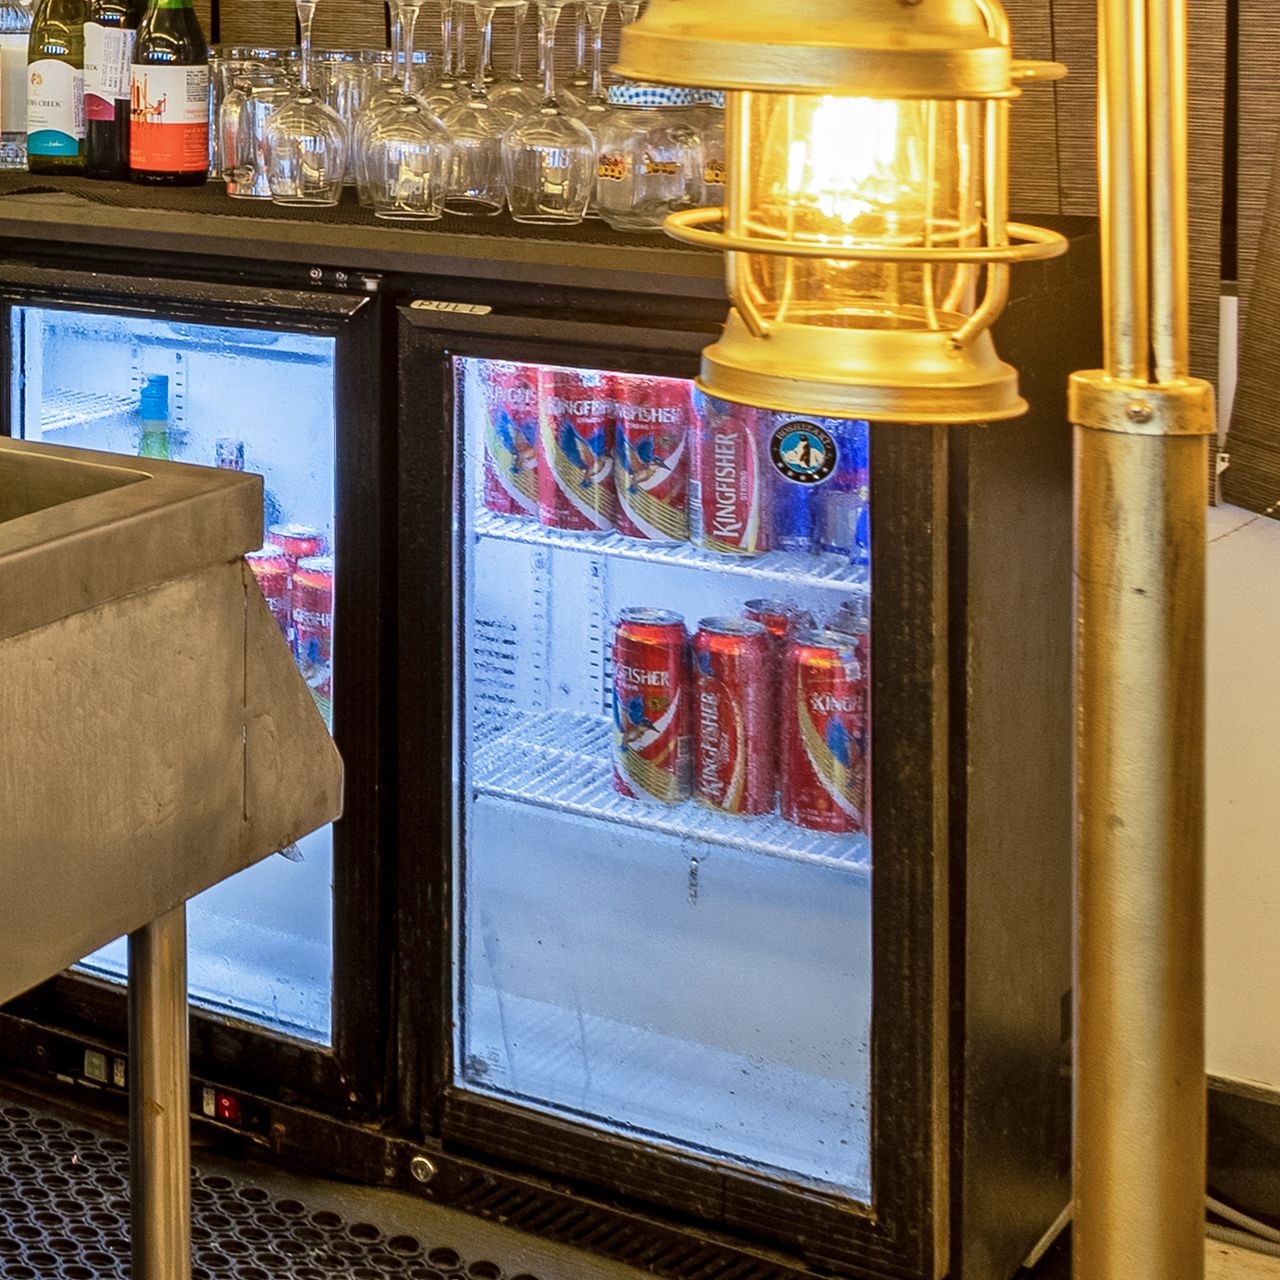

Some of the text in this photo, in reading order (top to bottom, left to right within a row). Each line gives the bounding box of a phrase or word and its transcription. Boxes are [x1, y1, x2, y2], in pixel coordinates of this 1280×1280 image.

[417, 299, 479, 313] PULL
[712, 432, 742, 538] KINGFISHER
[700, 691, 723, 797] KINGFISHER
